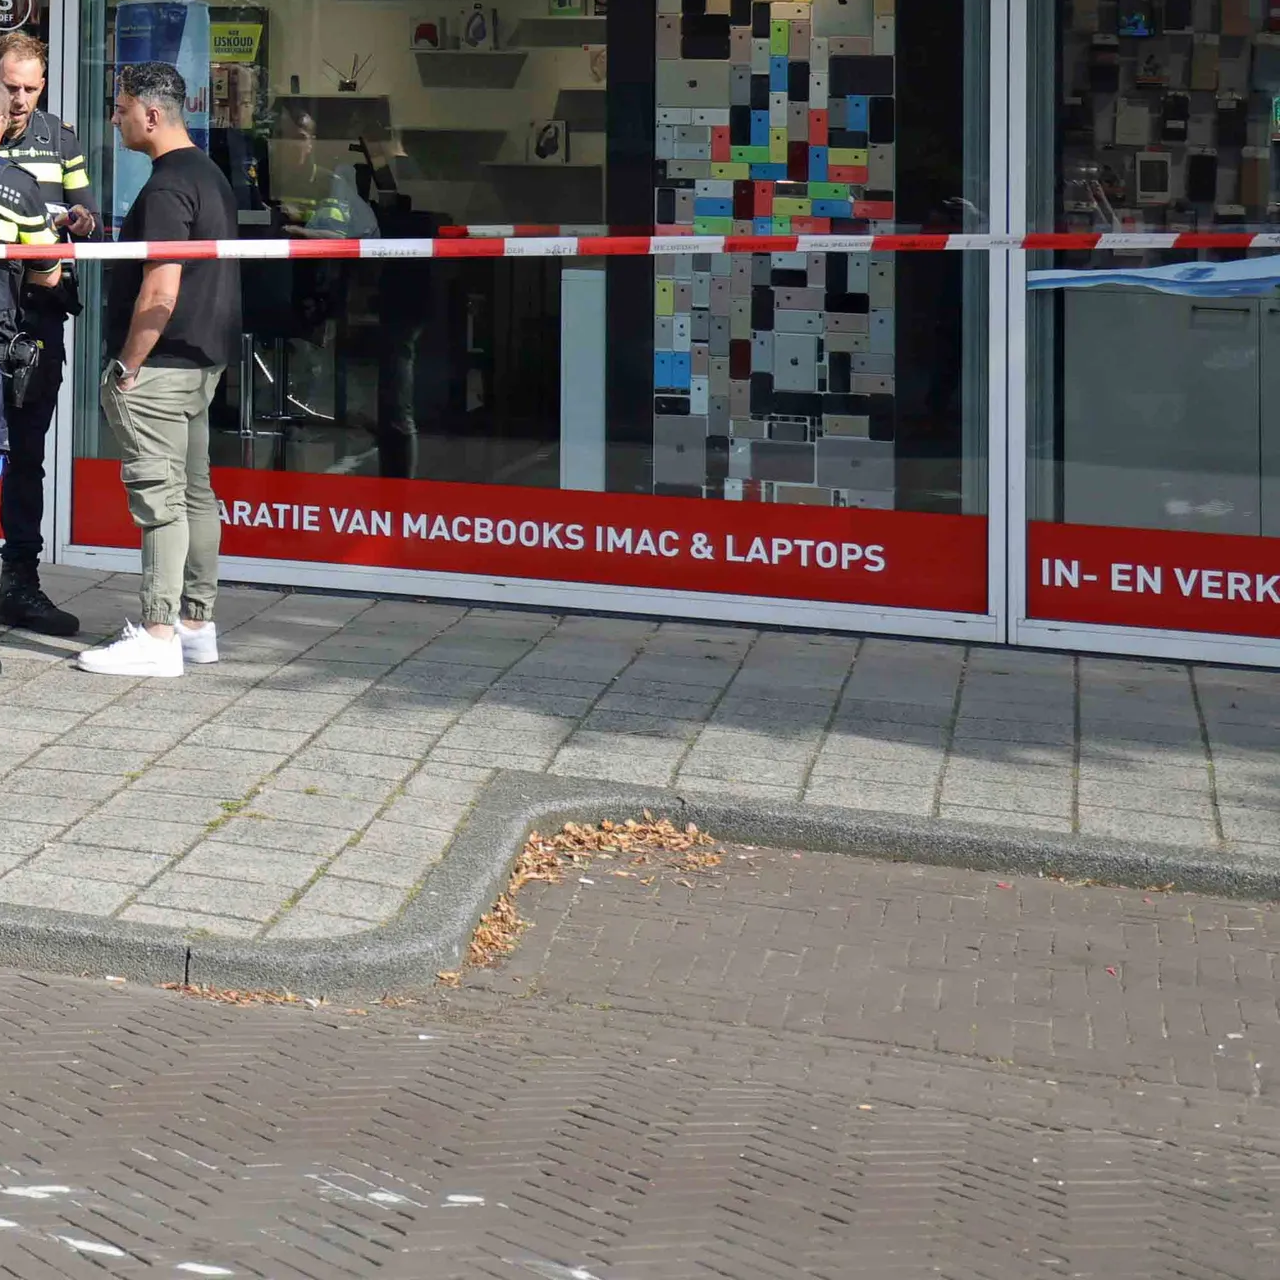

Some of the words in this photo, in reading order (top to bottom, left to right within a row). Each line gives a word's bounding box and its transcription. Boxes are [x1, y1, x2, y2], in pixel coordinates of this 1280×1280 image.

[214, 36, 253, 47] IJSKOUD
[185, 86, 207, 113] ull
[217, 499, 321, 532] ARATIE
[329, 506, 392, 537] VAN
[403, 512, 584, 551] MACBOOKS
[595, 525, 680, 558] IMAC
[690, 533, 715, 561] &
[726, 536, 886, 573] LAPTOPS
[1042, 558, 1098, 588] IN-
[1111, 563, 1162, 594] EN
[1173, 568, 1280, 605] VERK
